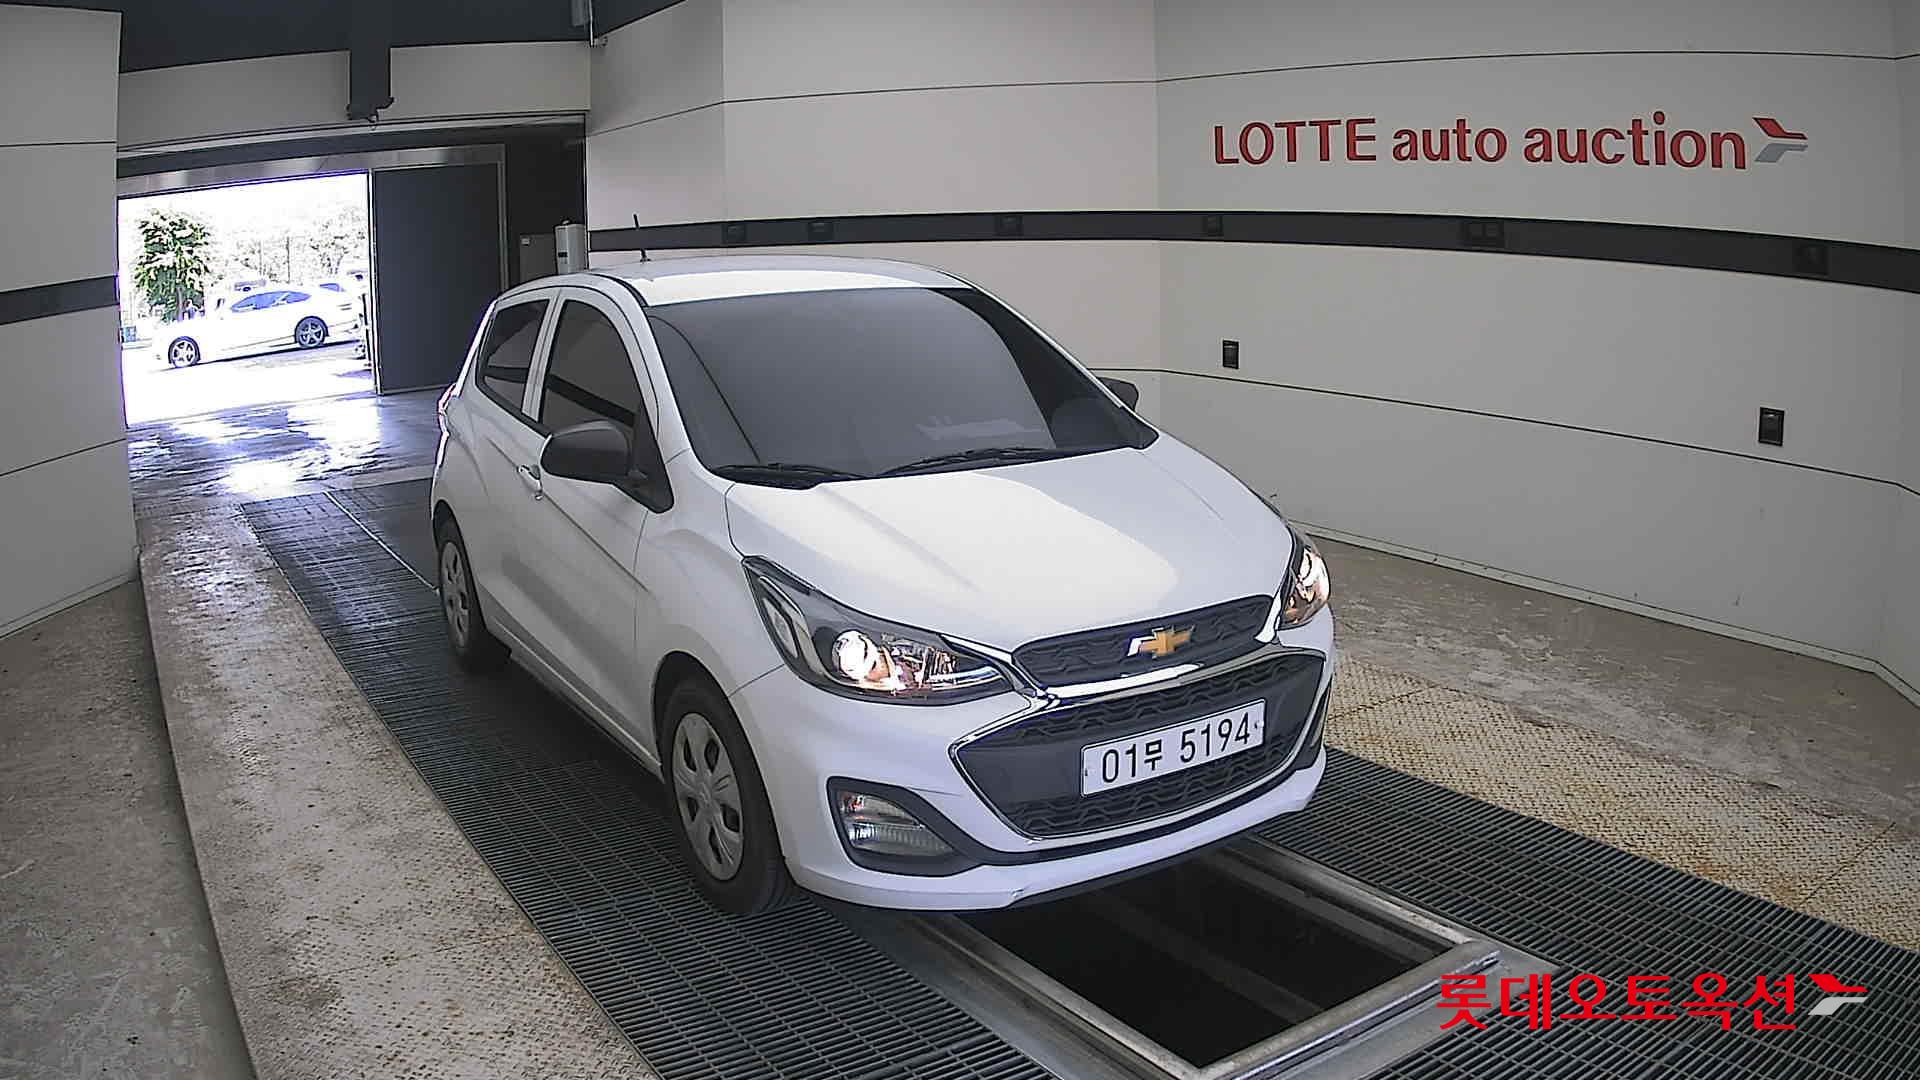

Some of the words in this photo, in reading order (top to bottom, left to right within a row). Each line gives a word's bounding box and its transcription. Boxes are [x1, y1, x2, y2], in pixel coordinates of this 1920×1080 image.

[1214, 117, 1377, 164] LOTTE
[1392, 118, 1508, 163] auto
[1523, 111, 1747, 169] auction
[1102, 738, 1164, 784] 01무
[1180, 711, 1251, 763] 5194
